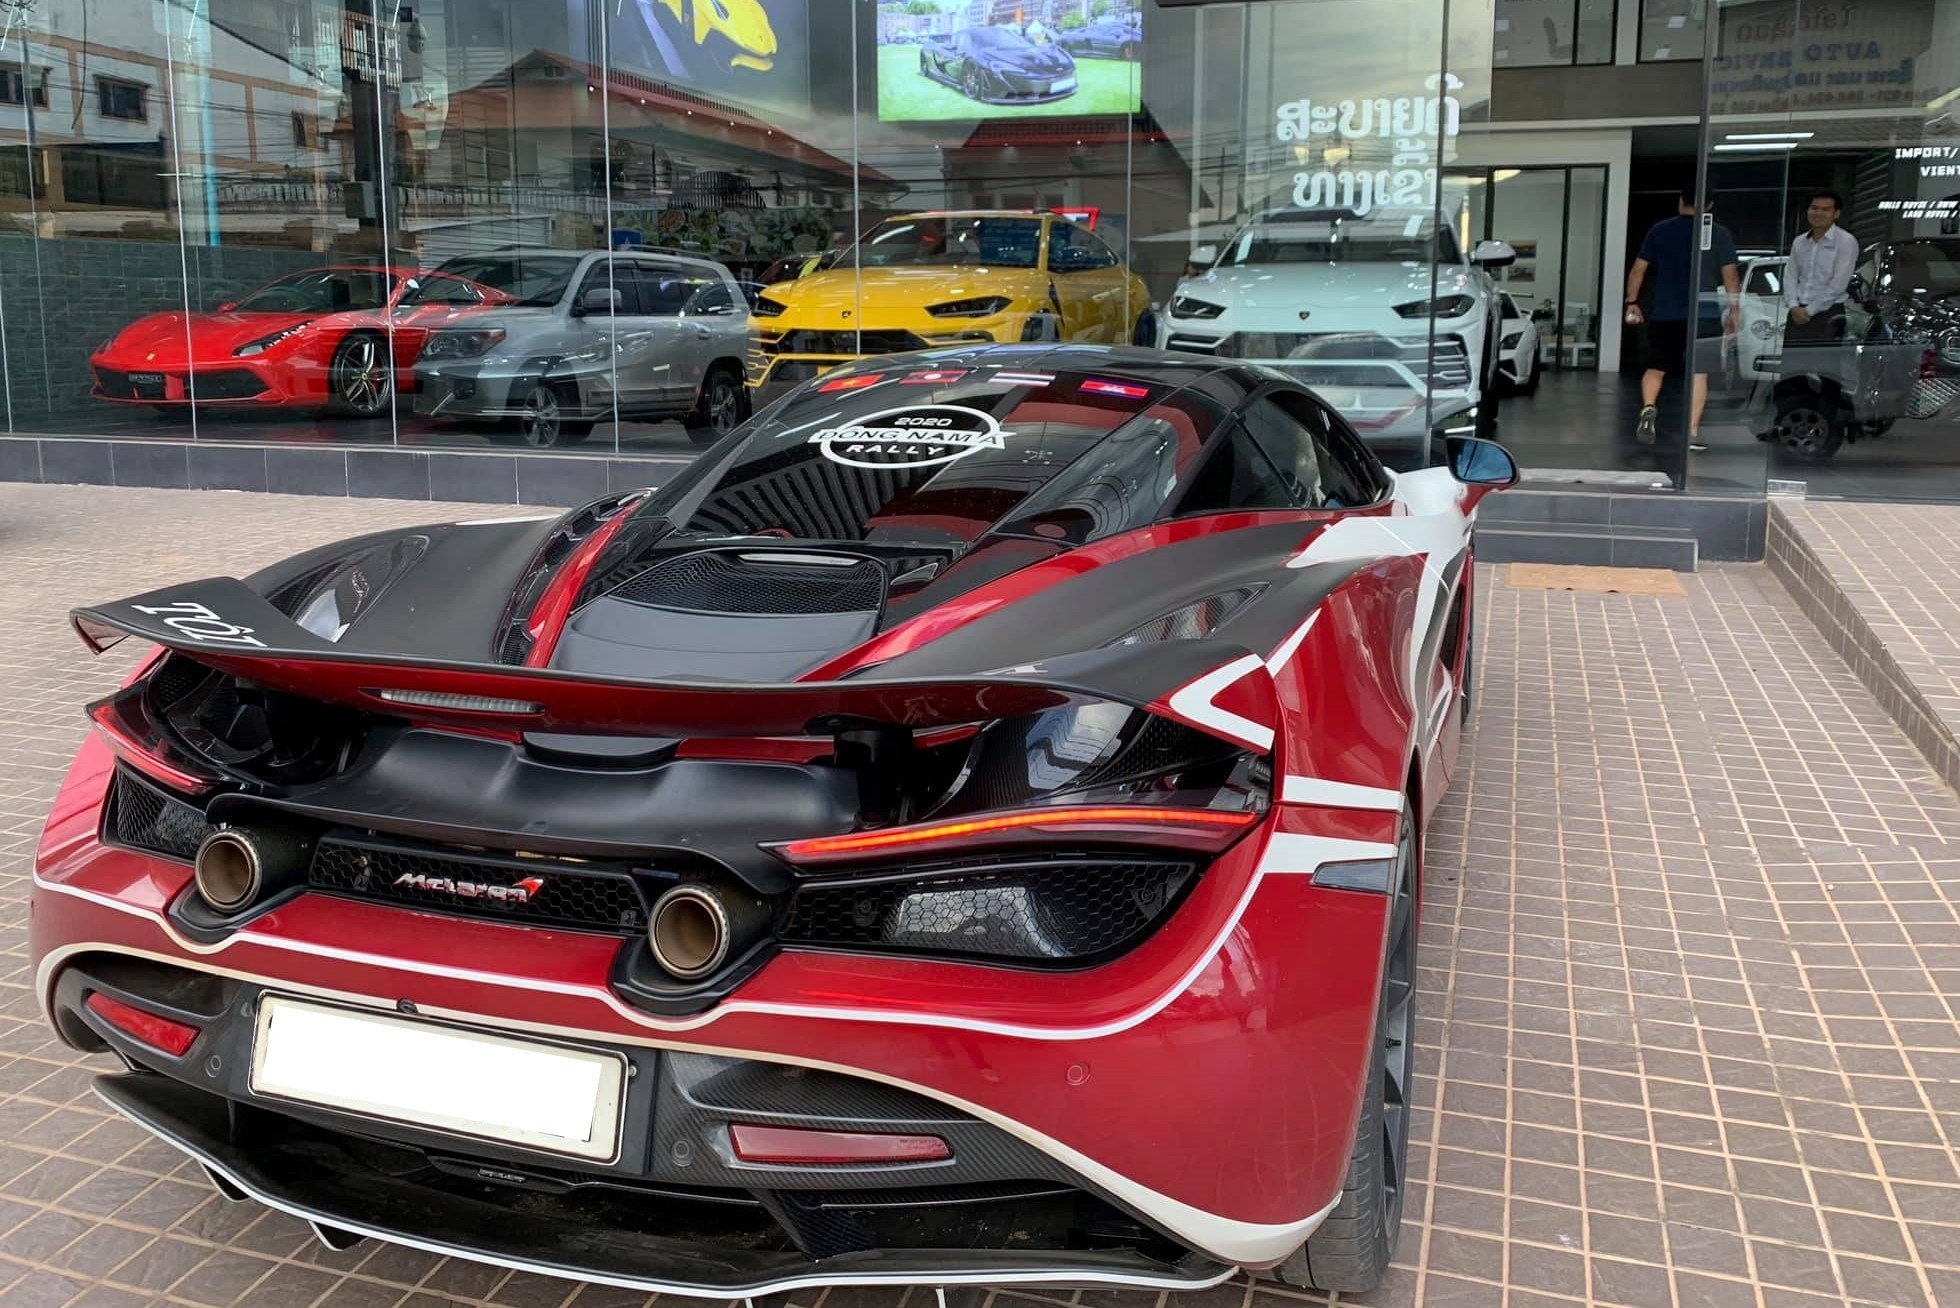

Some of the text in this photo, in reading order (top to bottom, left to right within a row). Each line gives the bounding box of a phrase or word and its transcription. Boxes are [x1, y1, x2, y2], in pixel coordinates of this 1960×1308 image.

[893, 416, 953, 427] 2020
[907, 431, 972, 443] NAM
[845, 444, 945, 456] RALLY
[392, 872, 528, 904] McLaren
